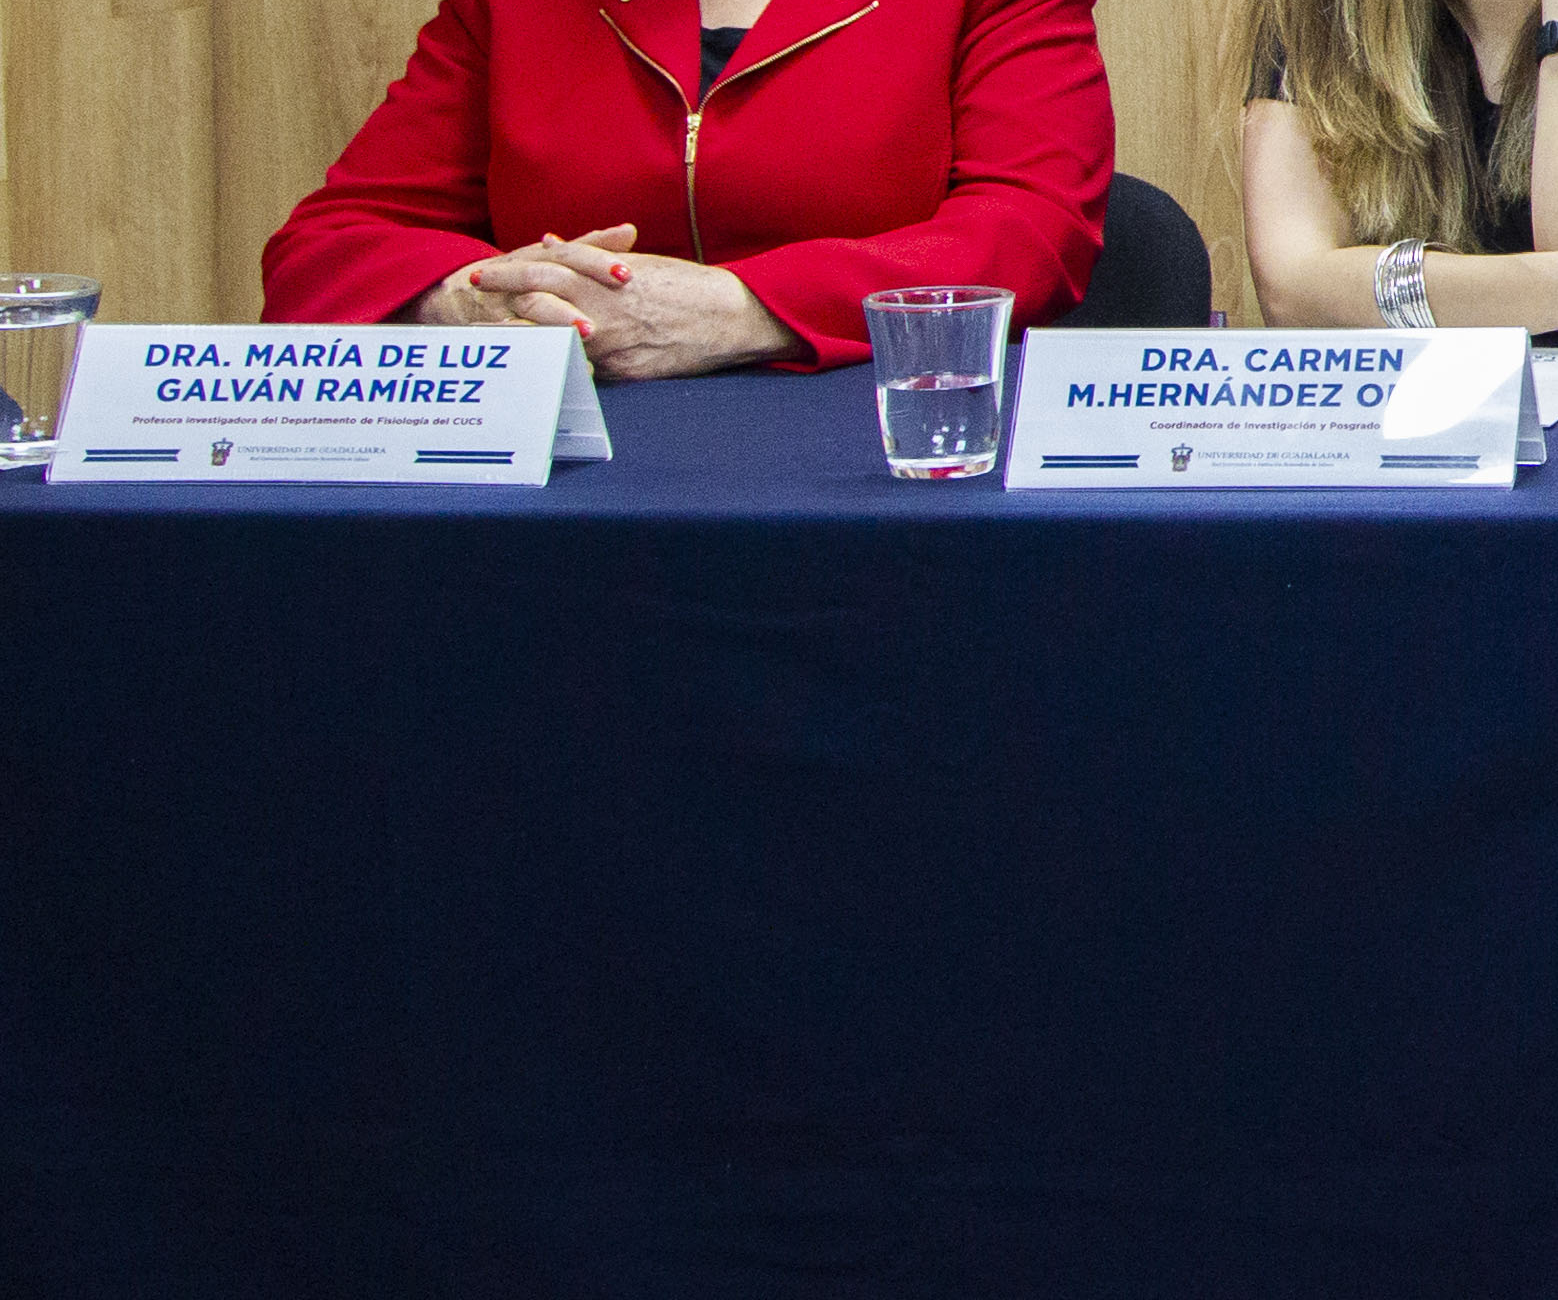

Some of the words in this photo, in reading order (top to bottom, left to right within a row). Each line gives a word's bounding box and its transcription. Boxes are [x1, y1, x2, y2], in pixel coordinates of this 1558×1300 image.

[144, 343, 231, 368] DRA.
[244, 338, 363, 368] MARÍA
[377, 344, 428, 368] DE
[438, 345, 511, 369] LUZ
[1140, 347, 1230, 372] DRA.
[1244, 347, 1404, 372] CARMEN
[156, 372, 305, 403] GALVÁN
[314, 374, 486, 403] RAMÍREZ
[1067, 377, 1344, 408] M.HERNÁNDEZ
[132, 415, 183, 425] Profesora
[261, 416, 278, 425] del
[281, 416, 357, 427] Departamento
[360, 416, 374, 425] de
[432, 417, 450, 426] del
[452, 416, 484, 426] CUCS
[1149, 420, 1224, 430] Coordinadora
[1227, 420, 1241, 430] de
[1244, 419, 1316, 432] Investigación
[1319, 422, 1327, 431] y
[1329, 420, 1381, 432] Posgrado
[1197, 451, 1264, 460] UNIVERSIDAD
[1280, 451, 1351, 460] GUADALAJARA
